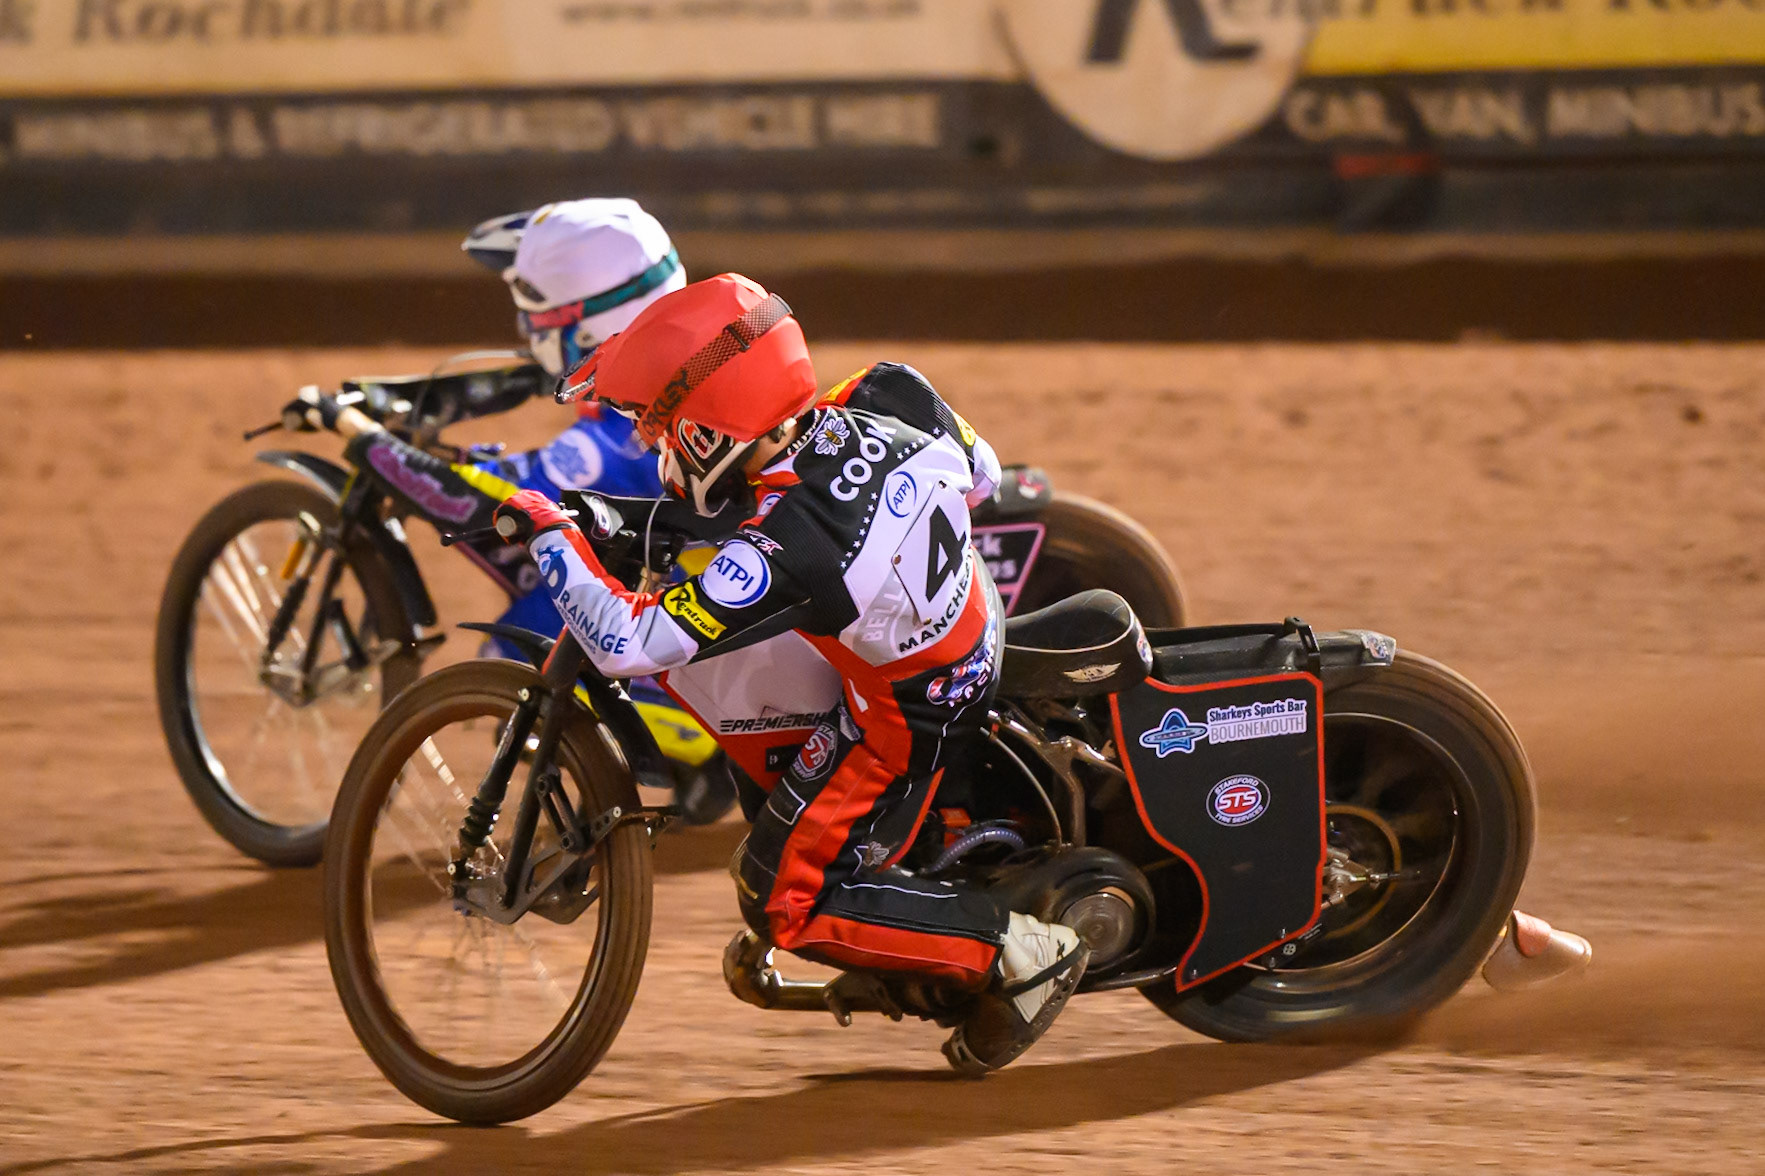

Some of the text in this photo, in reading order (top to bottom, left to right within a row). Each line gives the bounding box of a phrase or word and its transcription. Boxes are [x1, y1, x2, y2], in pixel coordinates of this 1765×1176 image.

[829, 418, 897, 502] COOK
[893, 480, 911, 510] ATPI
[925, 504, 966, 603] 4
[710, 555, 755, 591] ATPI
[669, 587, 717, 636] Rentruck
[861, 572, 905, 642] BELL
[1209, 701, 1304, 723] Sharkeys Sports Bar
[1211, 716, 1304, 742] BOURNEMOUTH
[1214, 777, 1259, 796] STAKEFORD
[1218, 790, 1257, 810] STS
